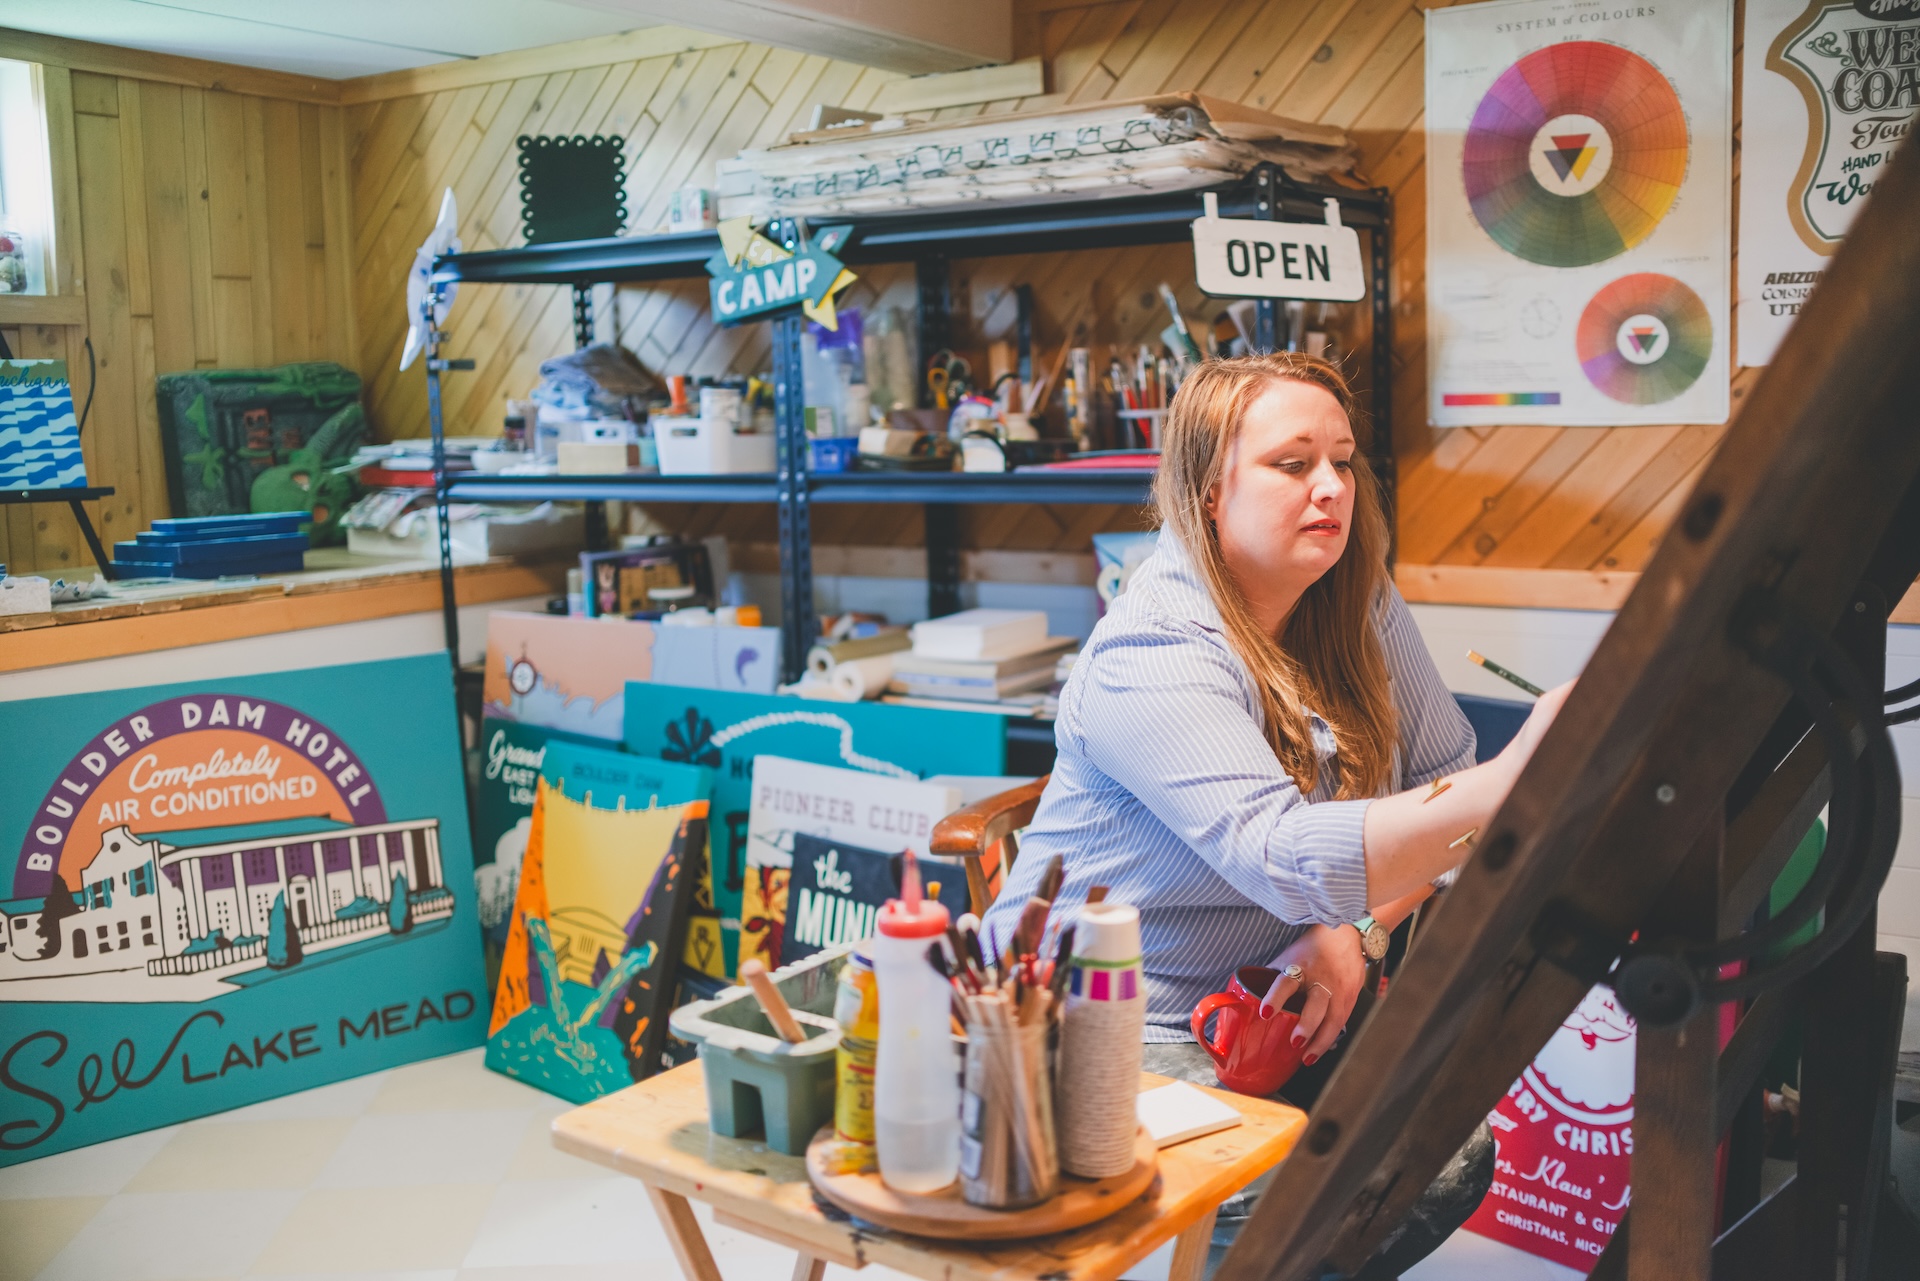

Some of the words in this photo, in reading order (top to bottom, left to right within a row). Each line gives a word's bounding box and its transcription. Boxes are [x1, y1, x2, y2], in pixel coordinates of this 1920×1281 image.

[1496, 17, 1557, 34] SYSTEM
[1562, 15, 1575, 25] of
[1579, 6, 1657, 24] COLOURS
[1841, 153, 1882, 174] HAND
[1226, 238, 1332, 282] OPEN
[717, 258, 817, 315] CAMP
[26, 714, 153, 873] BOULDER
[181, 699, 266, 730] DAM
[285, 718, 373, 807] HOTEL
[128, 745, 281, 794] Completely
[97, 789, 140, 825] AIR
[150, 774, 317, 818] CONDITIONED
[758, 785, 855, 825] PIONEER
[867, 803, 930, 839] CLUB
[812, 848, 853, 894] the
[181, 1024, 322, 1085] LAKE
[339, 989, 476, 1048] MEAD
[0, 1009, 225, 1151] See
[1487, 1180, 1569, 1219] STAURANT
[1574, 1211, 1587, 1227] &
[1495, 1209, 1569, 1246] CHRISTMAS,
